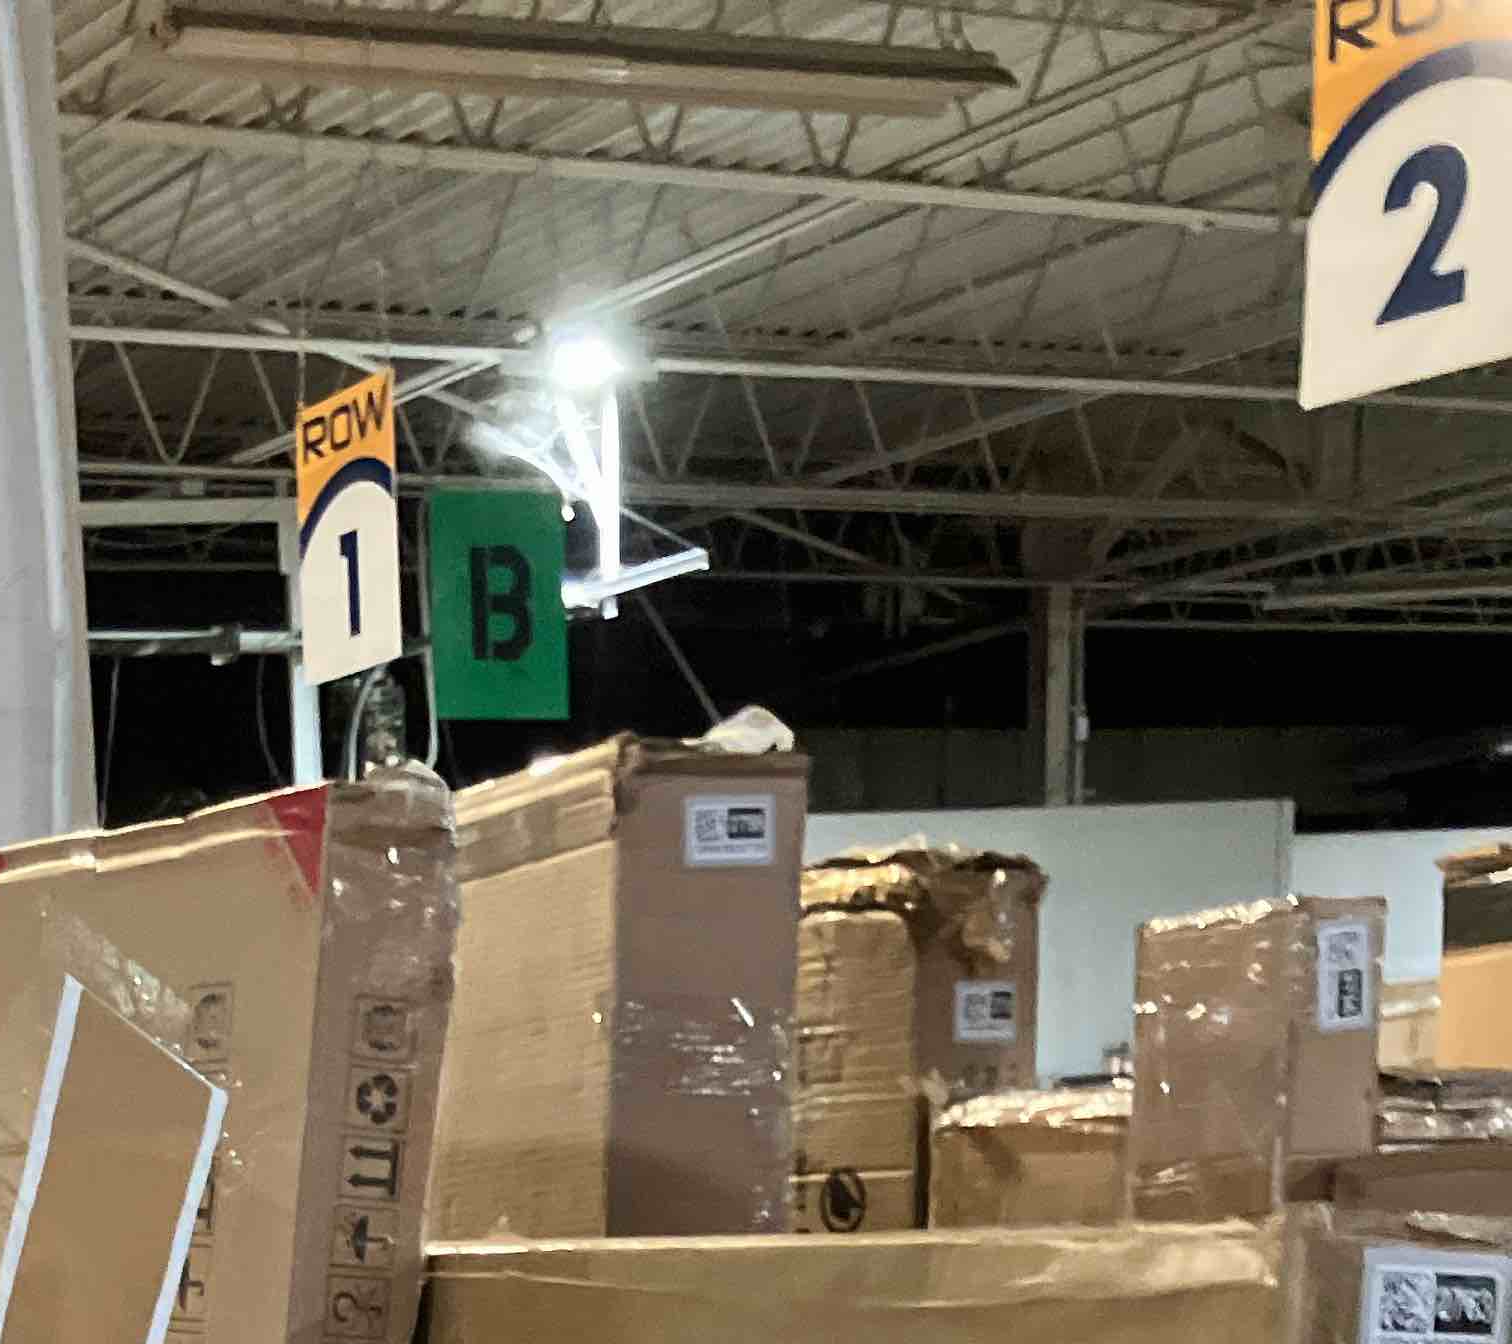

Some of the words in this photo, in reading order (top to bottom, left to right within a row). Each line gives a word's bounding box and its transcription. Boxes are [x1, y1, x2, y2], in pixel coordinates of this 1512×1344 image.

[1375, 144, 1468, 327] 2
[302, 383, 394, 464] ROW
[339, 529, 361, 638] 1
[471, 545, 534, 662] B
